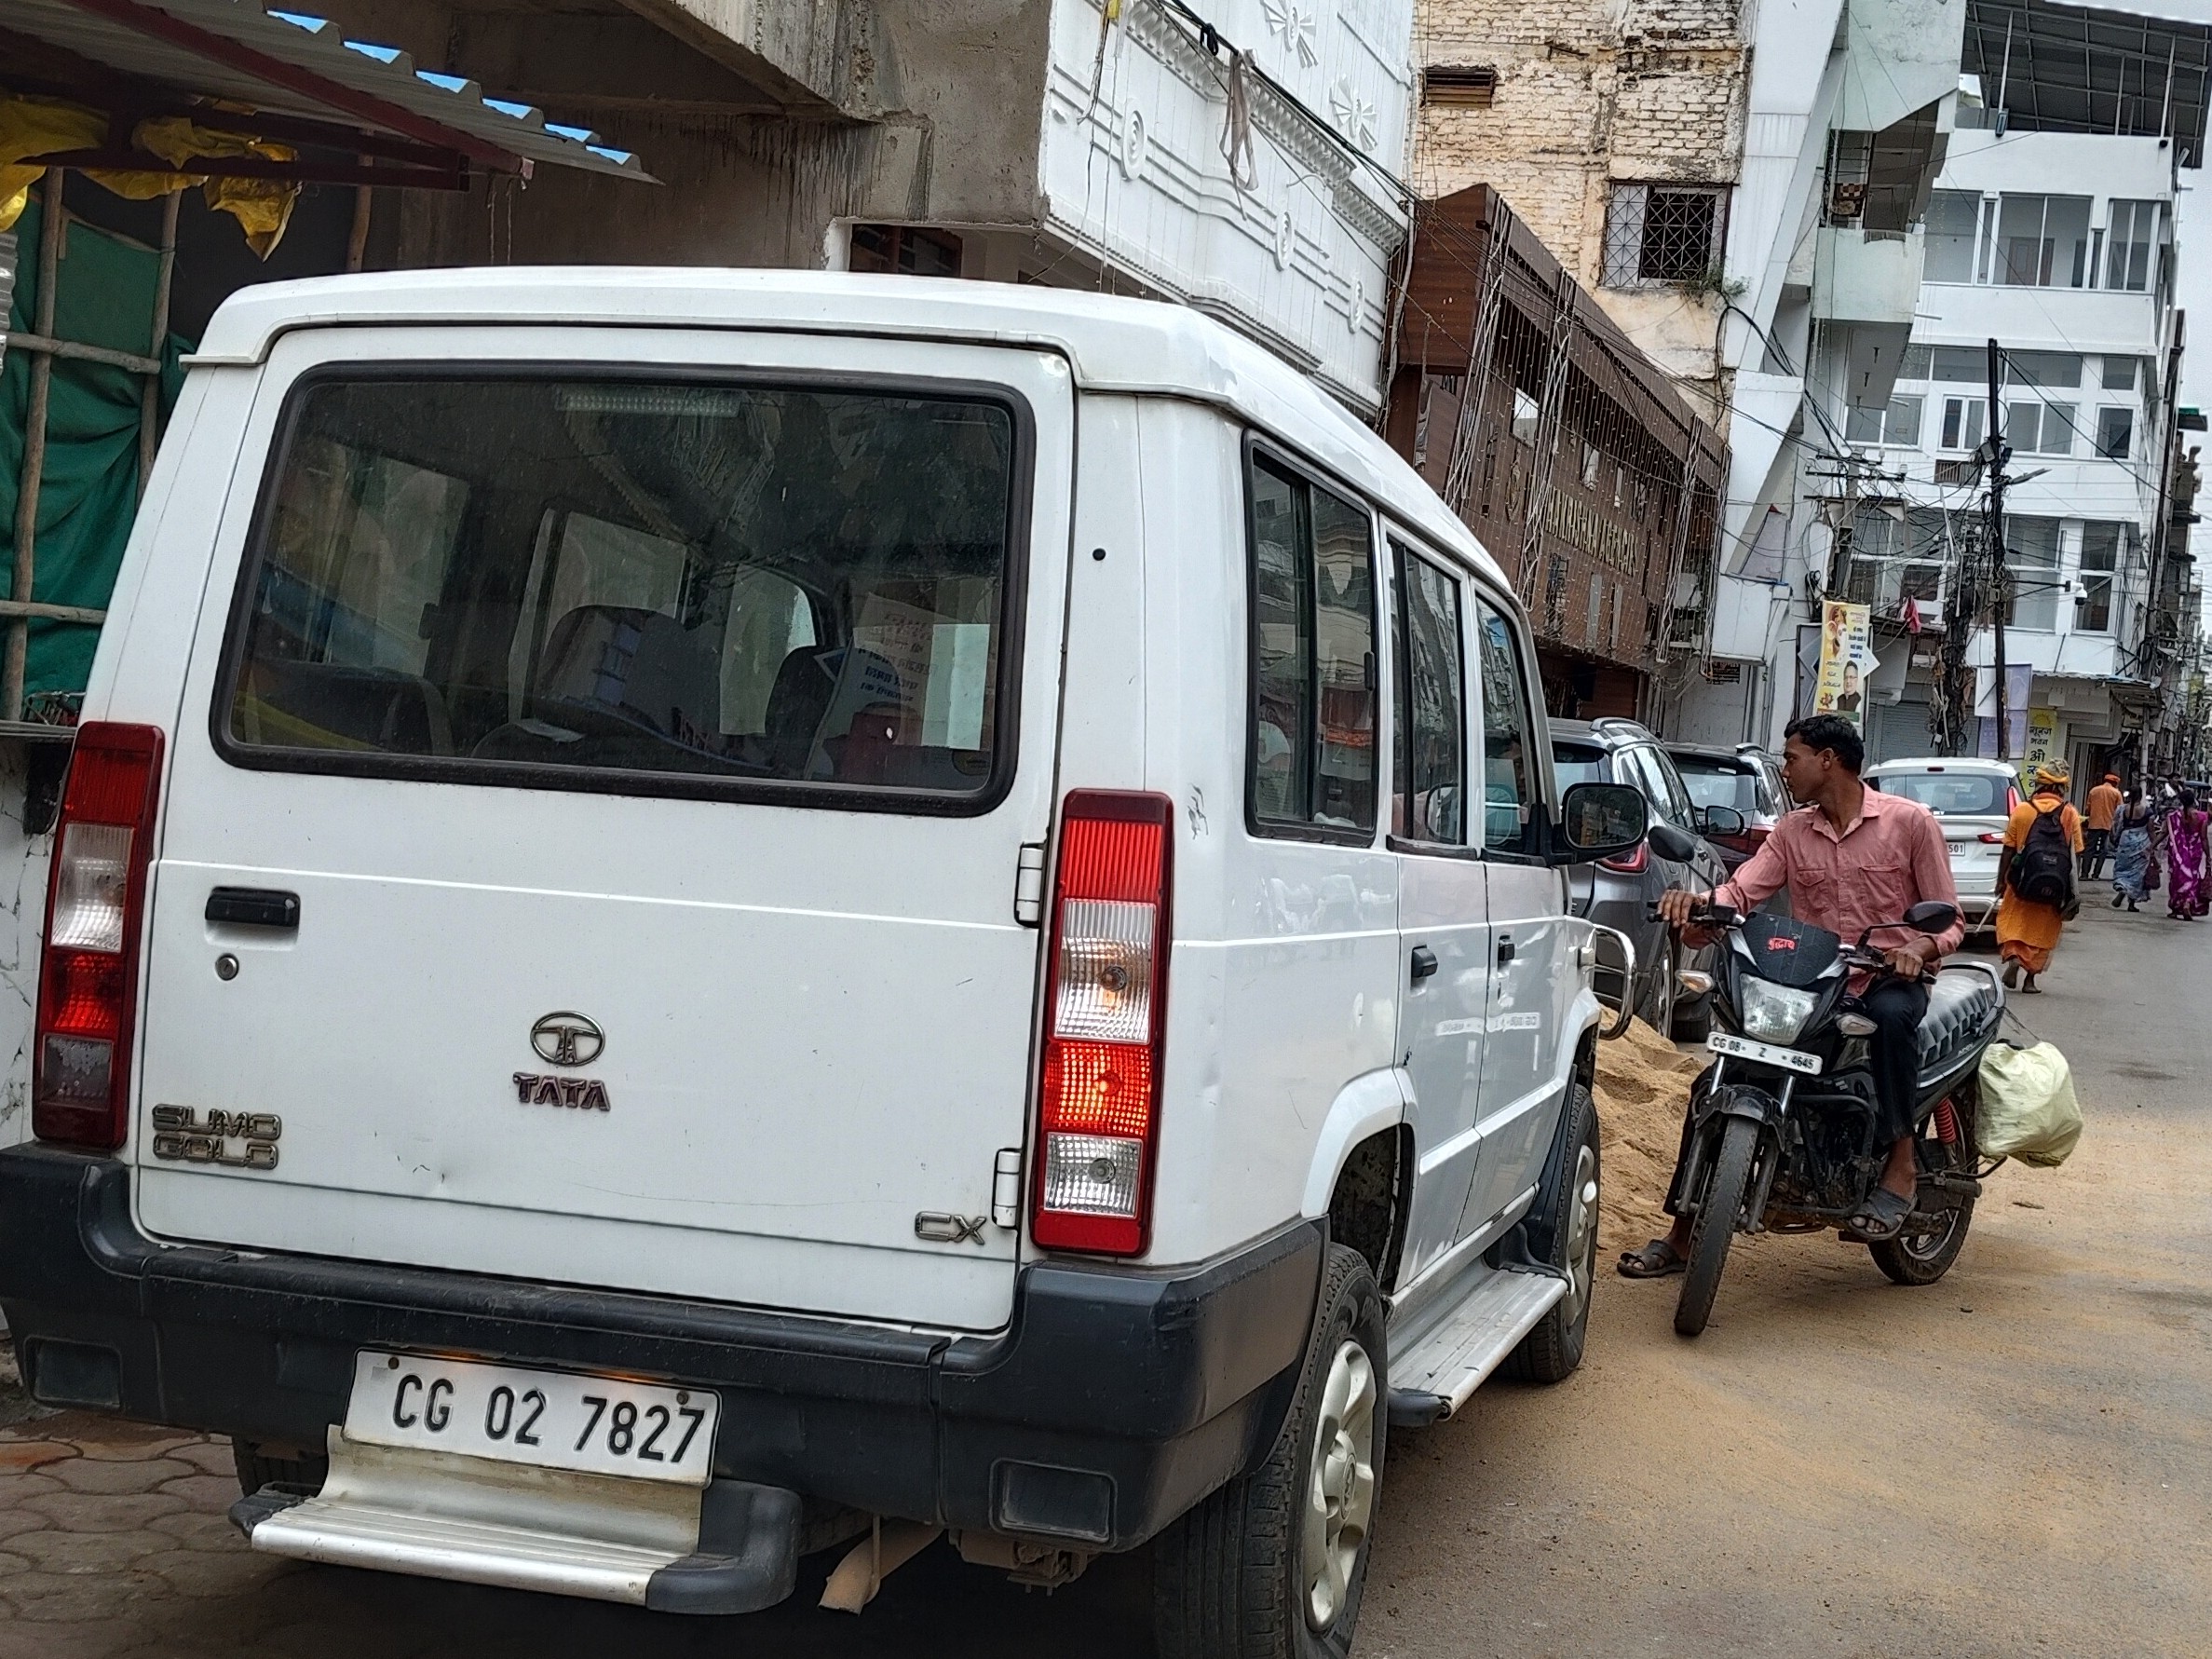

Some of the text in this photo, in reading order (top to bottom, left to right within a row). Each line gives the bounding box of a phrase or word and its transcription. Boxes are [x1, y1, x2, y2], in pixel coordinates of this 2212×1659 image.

[1947, 844, 1963, 853] 501
[1712, 1037, 1727, 1049] CG
[1791, 1054, 1814, 1070] 4645
[512, 1071, 611, 1112] TATA
[152, 1103, 282, 1141] SUMO
[153, 1132, 279, 1170] GOLD
[915, 1211, 987, 1245] CX
[392, 1373, 706, 1464] CG 02 7827
